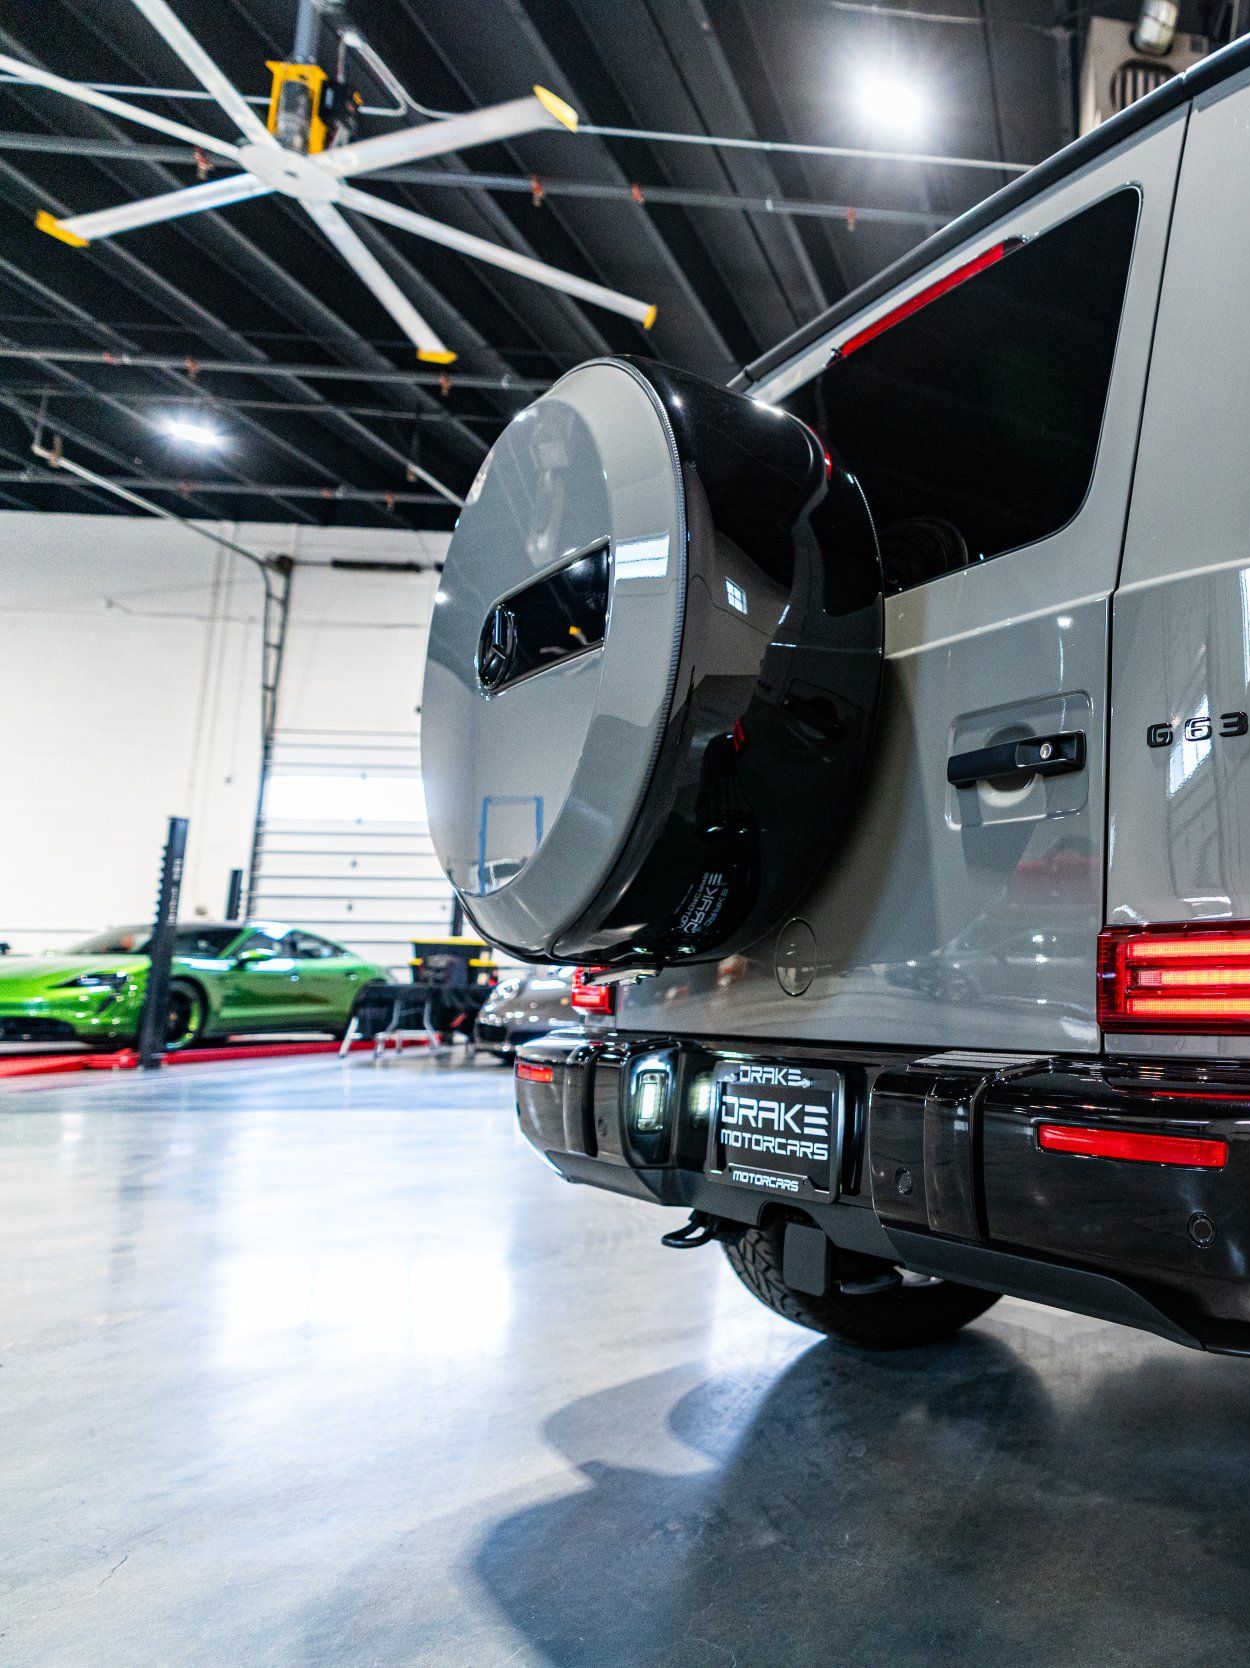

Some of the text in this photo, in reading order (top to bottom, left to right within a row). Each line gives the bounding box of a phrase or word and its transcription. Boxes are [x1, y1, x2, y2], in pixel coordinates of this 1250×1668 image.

[739, 1065, 802, 1087] DRAKE
[721, 1095, 829, 1137] DRAKE
[720, 1129, 829, 1161] MOTORCARS
[732, 1170, 799, 1193] MOTORCARS
